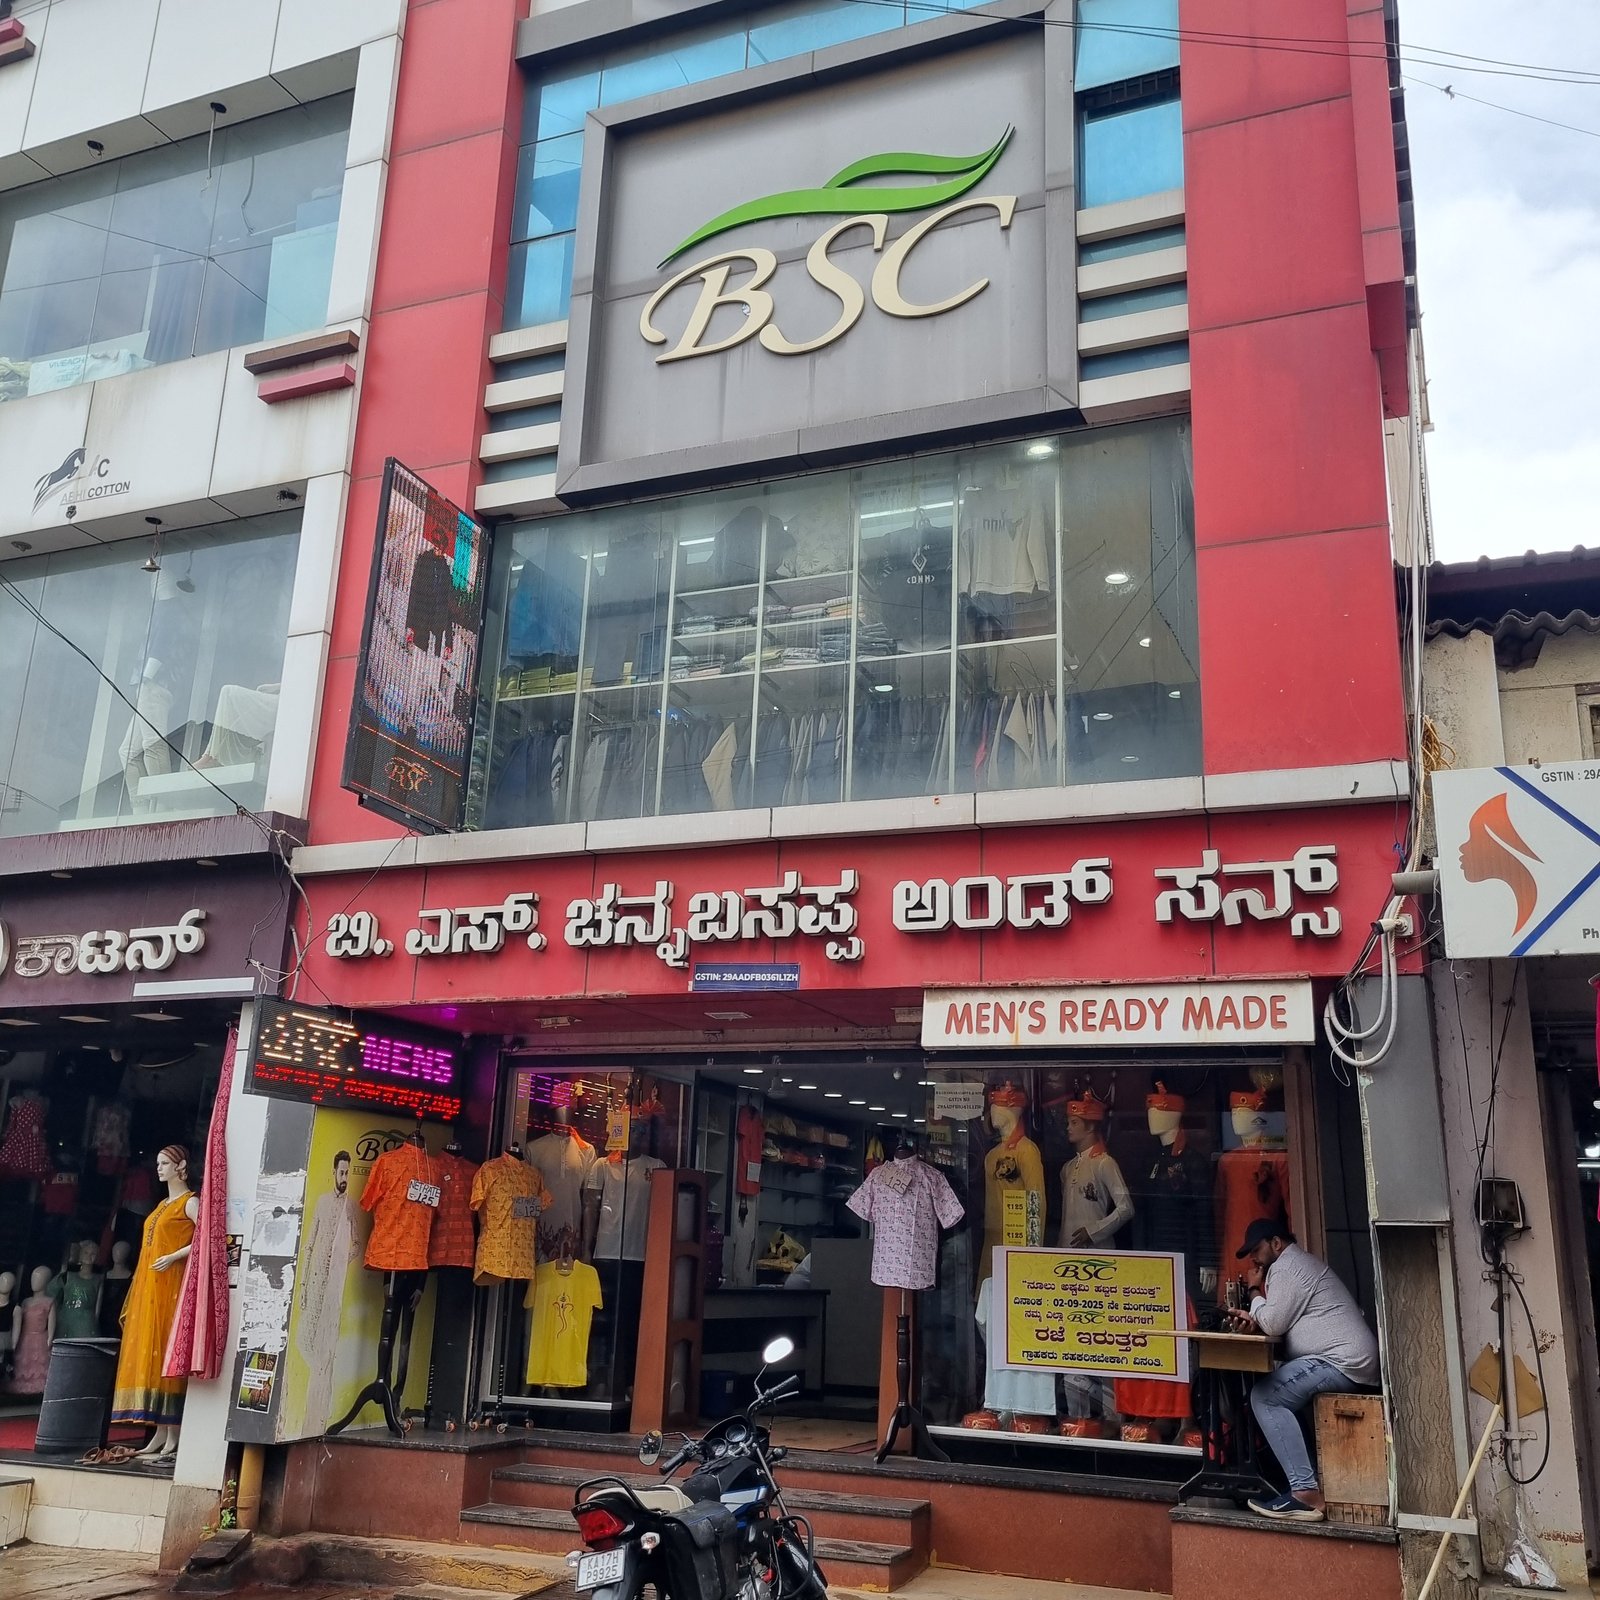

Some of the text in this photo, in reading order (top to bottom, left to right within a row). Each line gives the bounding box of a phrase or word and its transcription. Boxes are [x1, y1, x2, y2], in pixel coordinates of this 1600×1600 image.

[639, 195, 1018, 363] BSC
[87, 481, 131, 498] COTTON
[1541, 770, 1575, 783] GSTIN
[325, 911, 394, 959] ಬಿ.
[405, 892, 547, 957] ಎಸ್.
[892, 857, 1113, 933] ಅಂಡ್
[1154, 844, 1342, 938] ಸನ್ಸ್
[14, 908, 207, 977] ಕಾಟನ್
[695, 972, 721, 981] GSTIN:
[945, 995, 1288, 1035] MEN'S READY MADE
[362, 1035, 452, 1084] MENS
[417, 1192, 434, 1205] 125
[525, 1205, 541, 1217] 125
[1053, 1264, 1117, 1281] BSC
[1053, 1298, 1104, 1309] 02-09-2025
[1035, 1325, 1065, 1343] ರಜೆ
[586, 1564, 618, 1583] P9925
